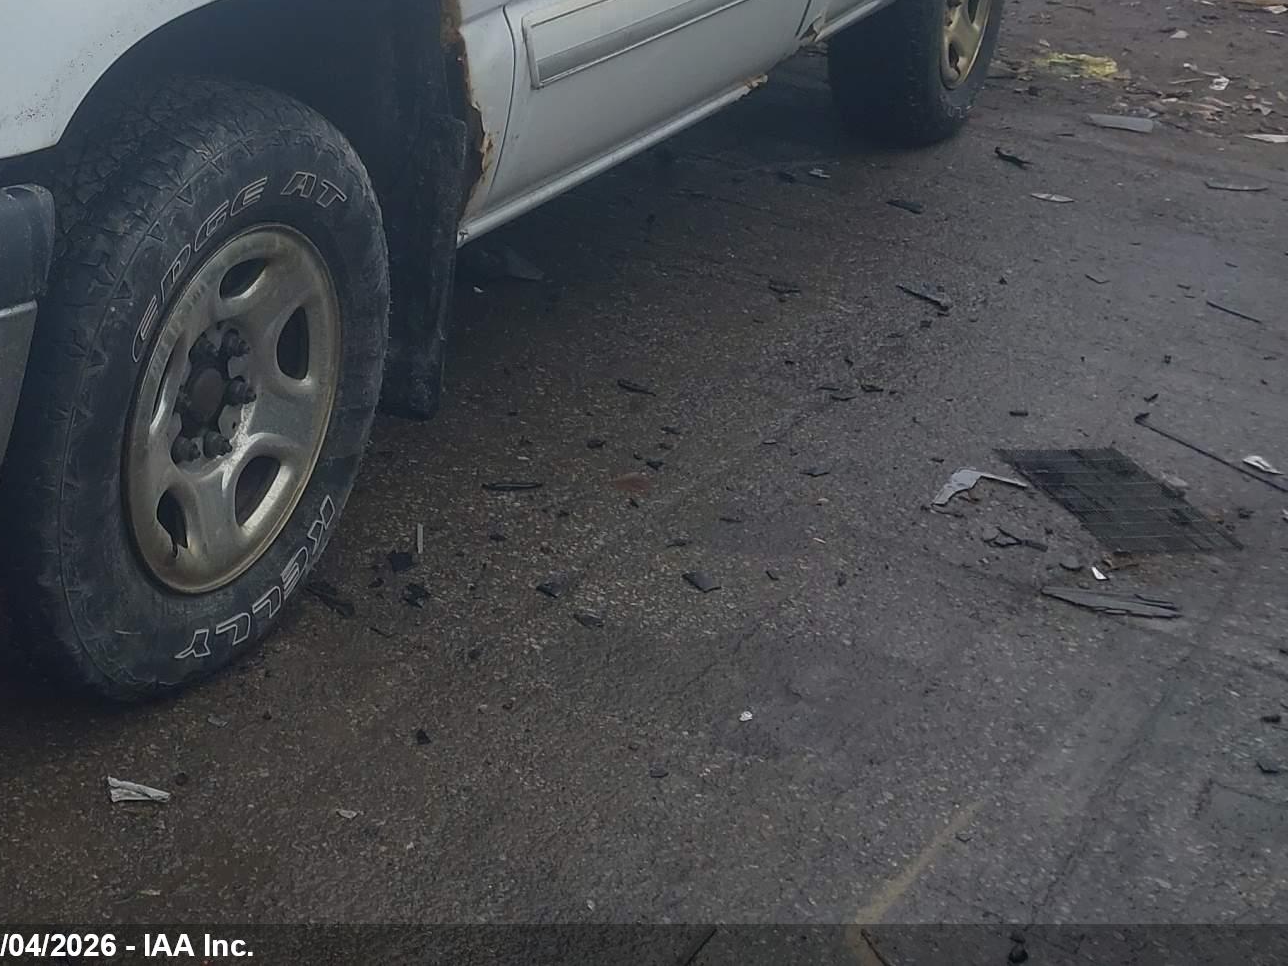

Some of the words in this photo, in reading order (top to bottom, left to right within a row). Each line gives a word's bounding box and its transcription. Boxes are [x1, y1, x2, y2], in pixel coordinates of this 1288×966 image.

[132, 177, 268, 363] EDGE
[280, 171, 348, 208] AT
[174, 495, 336, 659] KELLY
